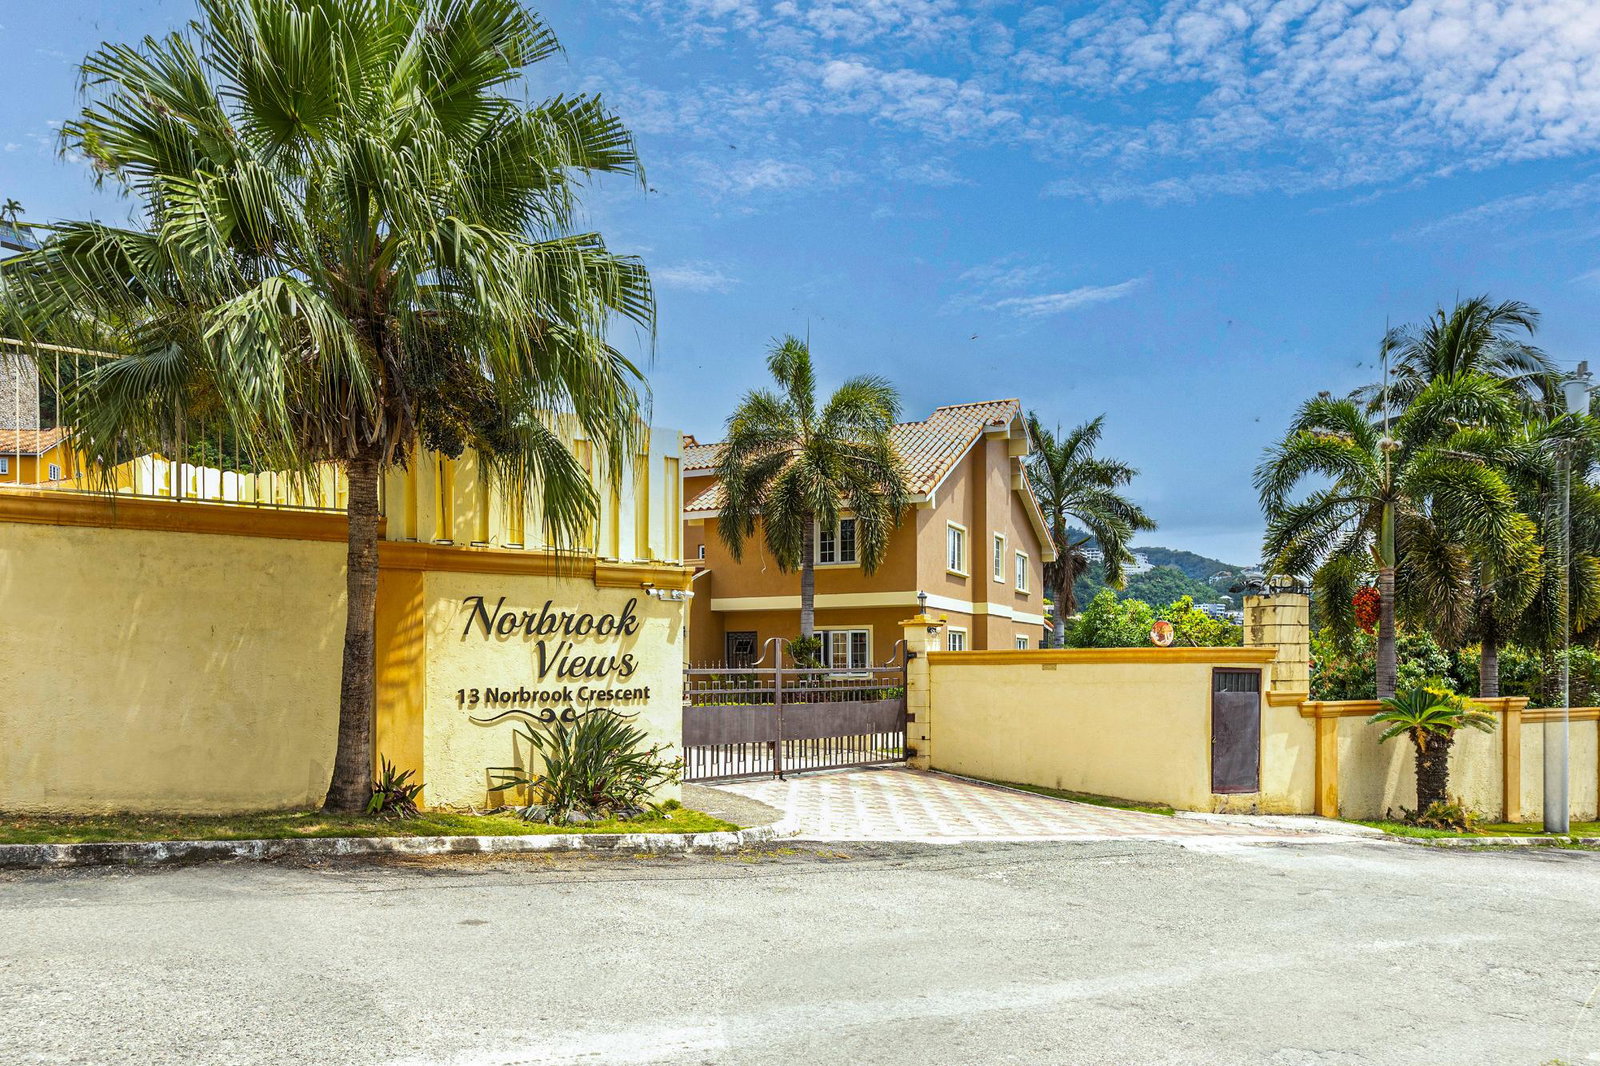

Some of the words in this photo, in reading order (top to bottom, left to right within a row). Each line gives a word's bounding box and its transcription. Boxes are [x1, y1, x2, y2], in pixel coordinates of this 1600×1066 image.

[463, 596, 639, 636] Norbrook
[536, 640, 639, 678] Views
[457, 688, 480, 704] 13
[486, 686, 573, 704] Norbrook
[578, 686, 651, 701] Crescent
